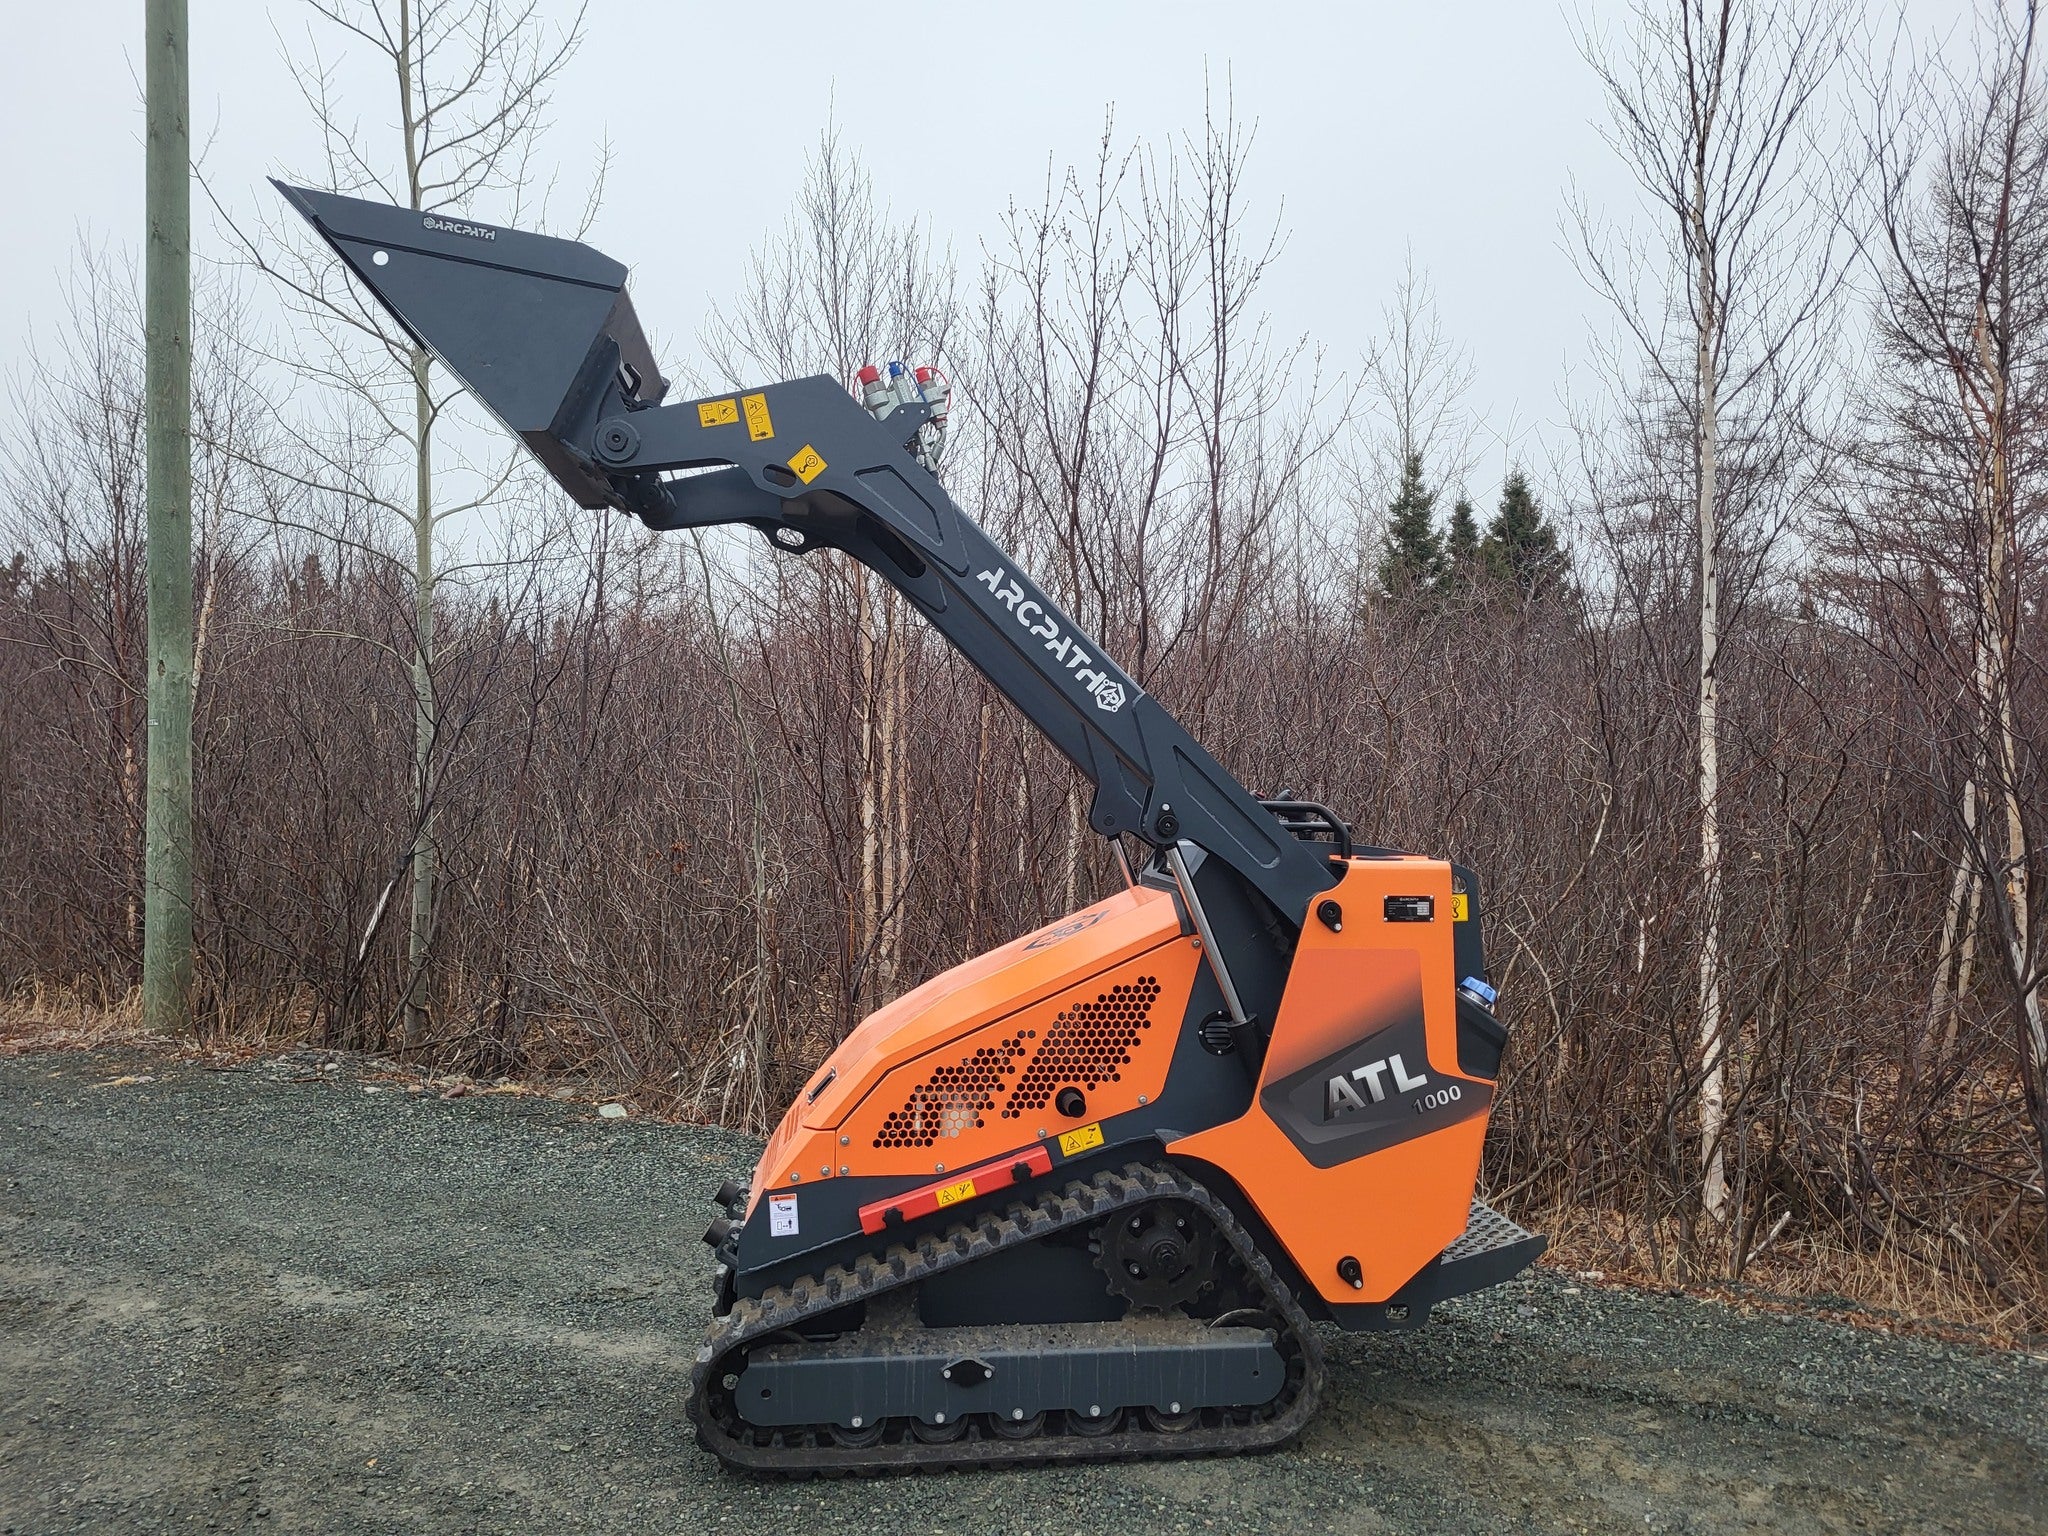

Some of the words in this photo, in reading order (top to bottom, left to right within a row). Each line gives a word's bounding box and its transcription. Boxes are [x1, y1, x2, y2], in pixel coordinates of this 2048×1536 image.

[435, 220, 496, 240] ARCPATH
[976, 567, 1107, 693] ARCPATH
[1325, 1053, 1428, 1120] ATL
[1412, 1085, 1462, 1114] 1000
